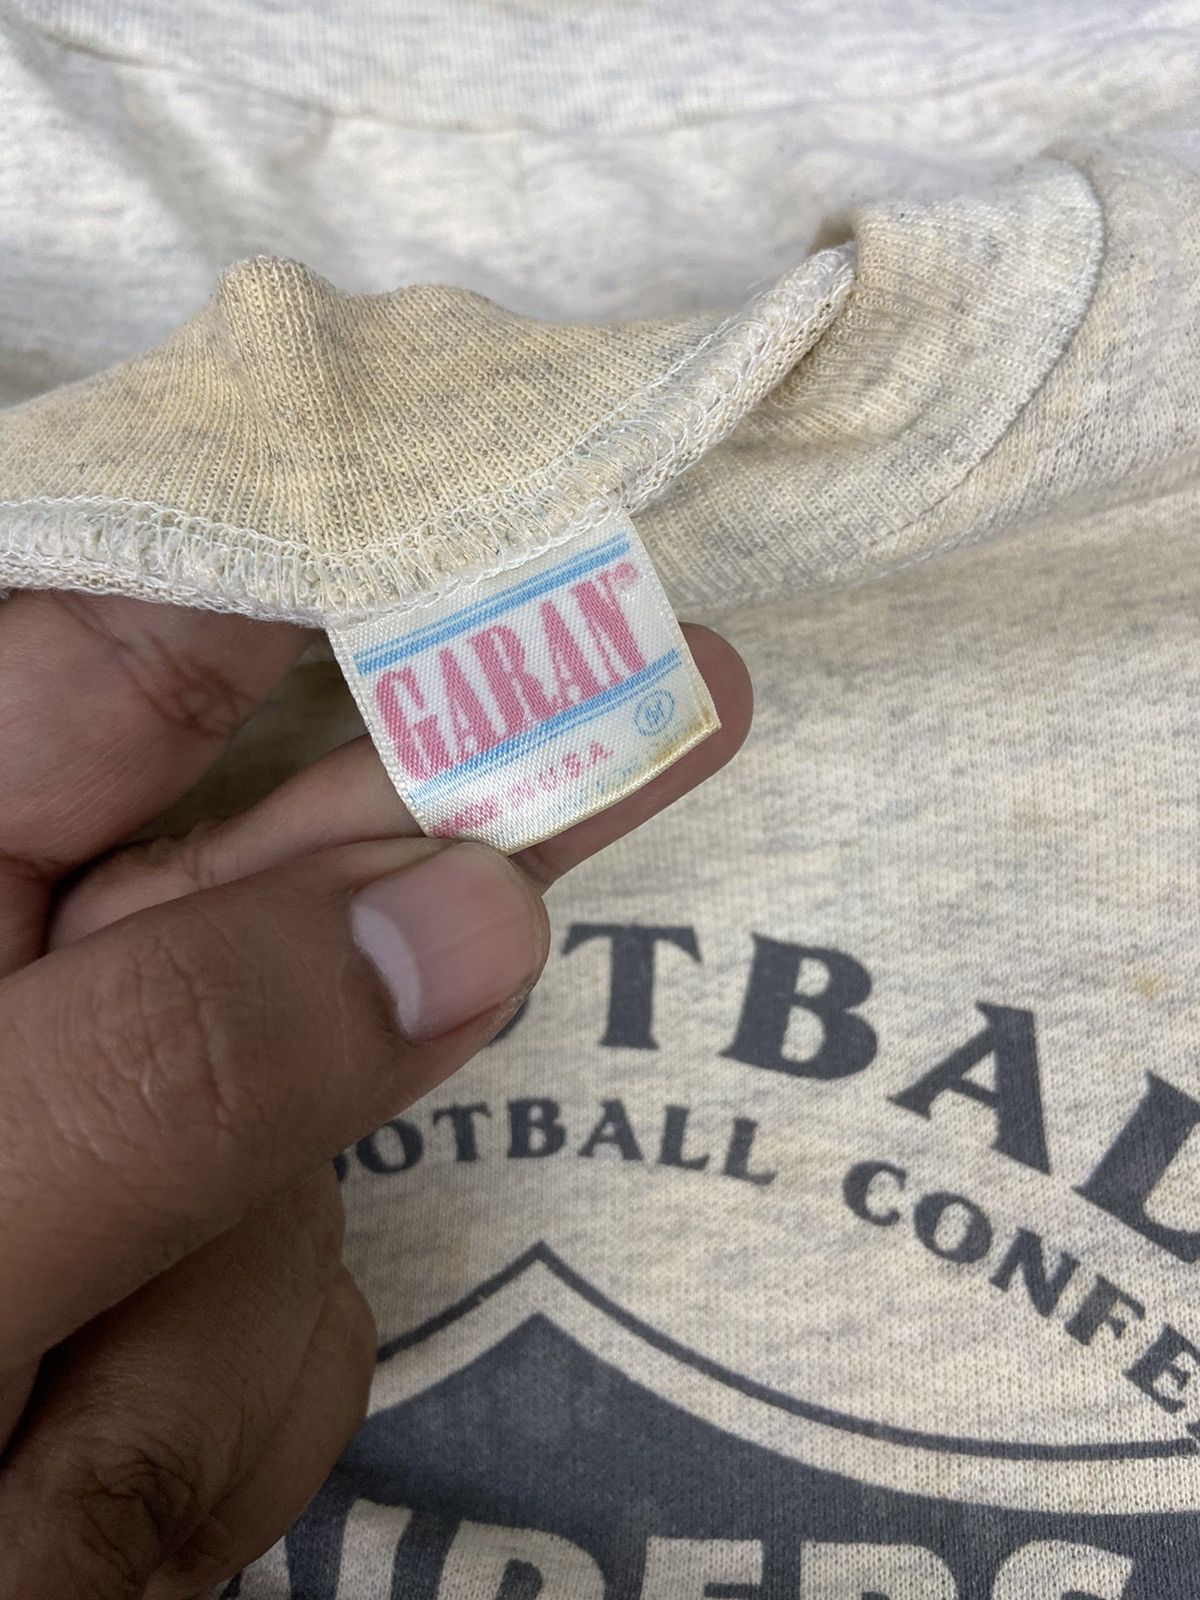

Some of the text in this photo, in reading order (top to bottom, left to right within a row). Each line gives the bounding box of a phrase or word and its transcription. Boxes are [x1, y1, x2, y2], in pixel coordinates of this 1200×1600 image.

[375, 562, 647, 781] GARAN
[488, 920, 1200, 1265] TBAL
[332, 1097, 1200, 1440] OTBALL CONFE
